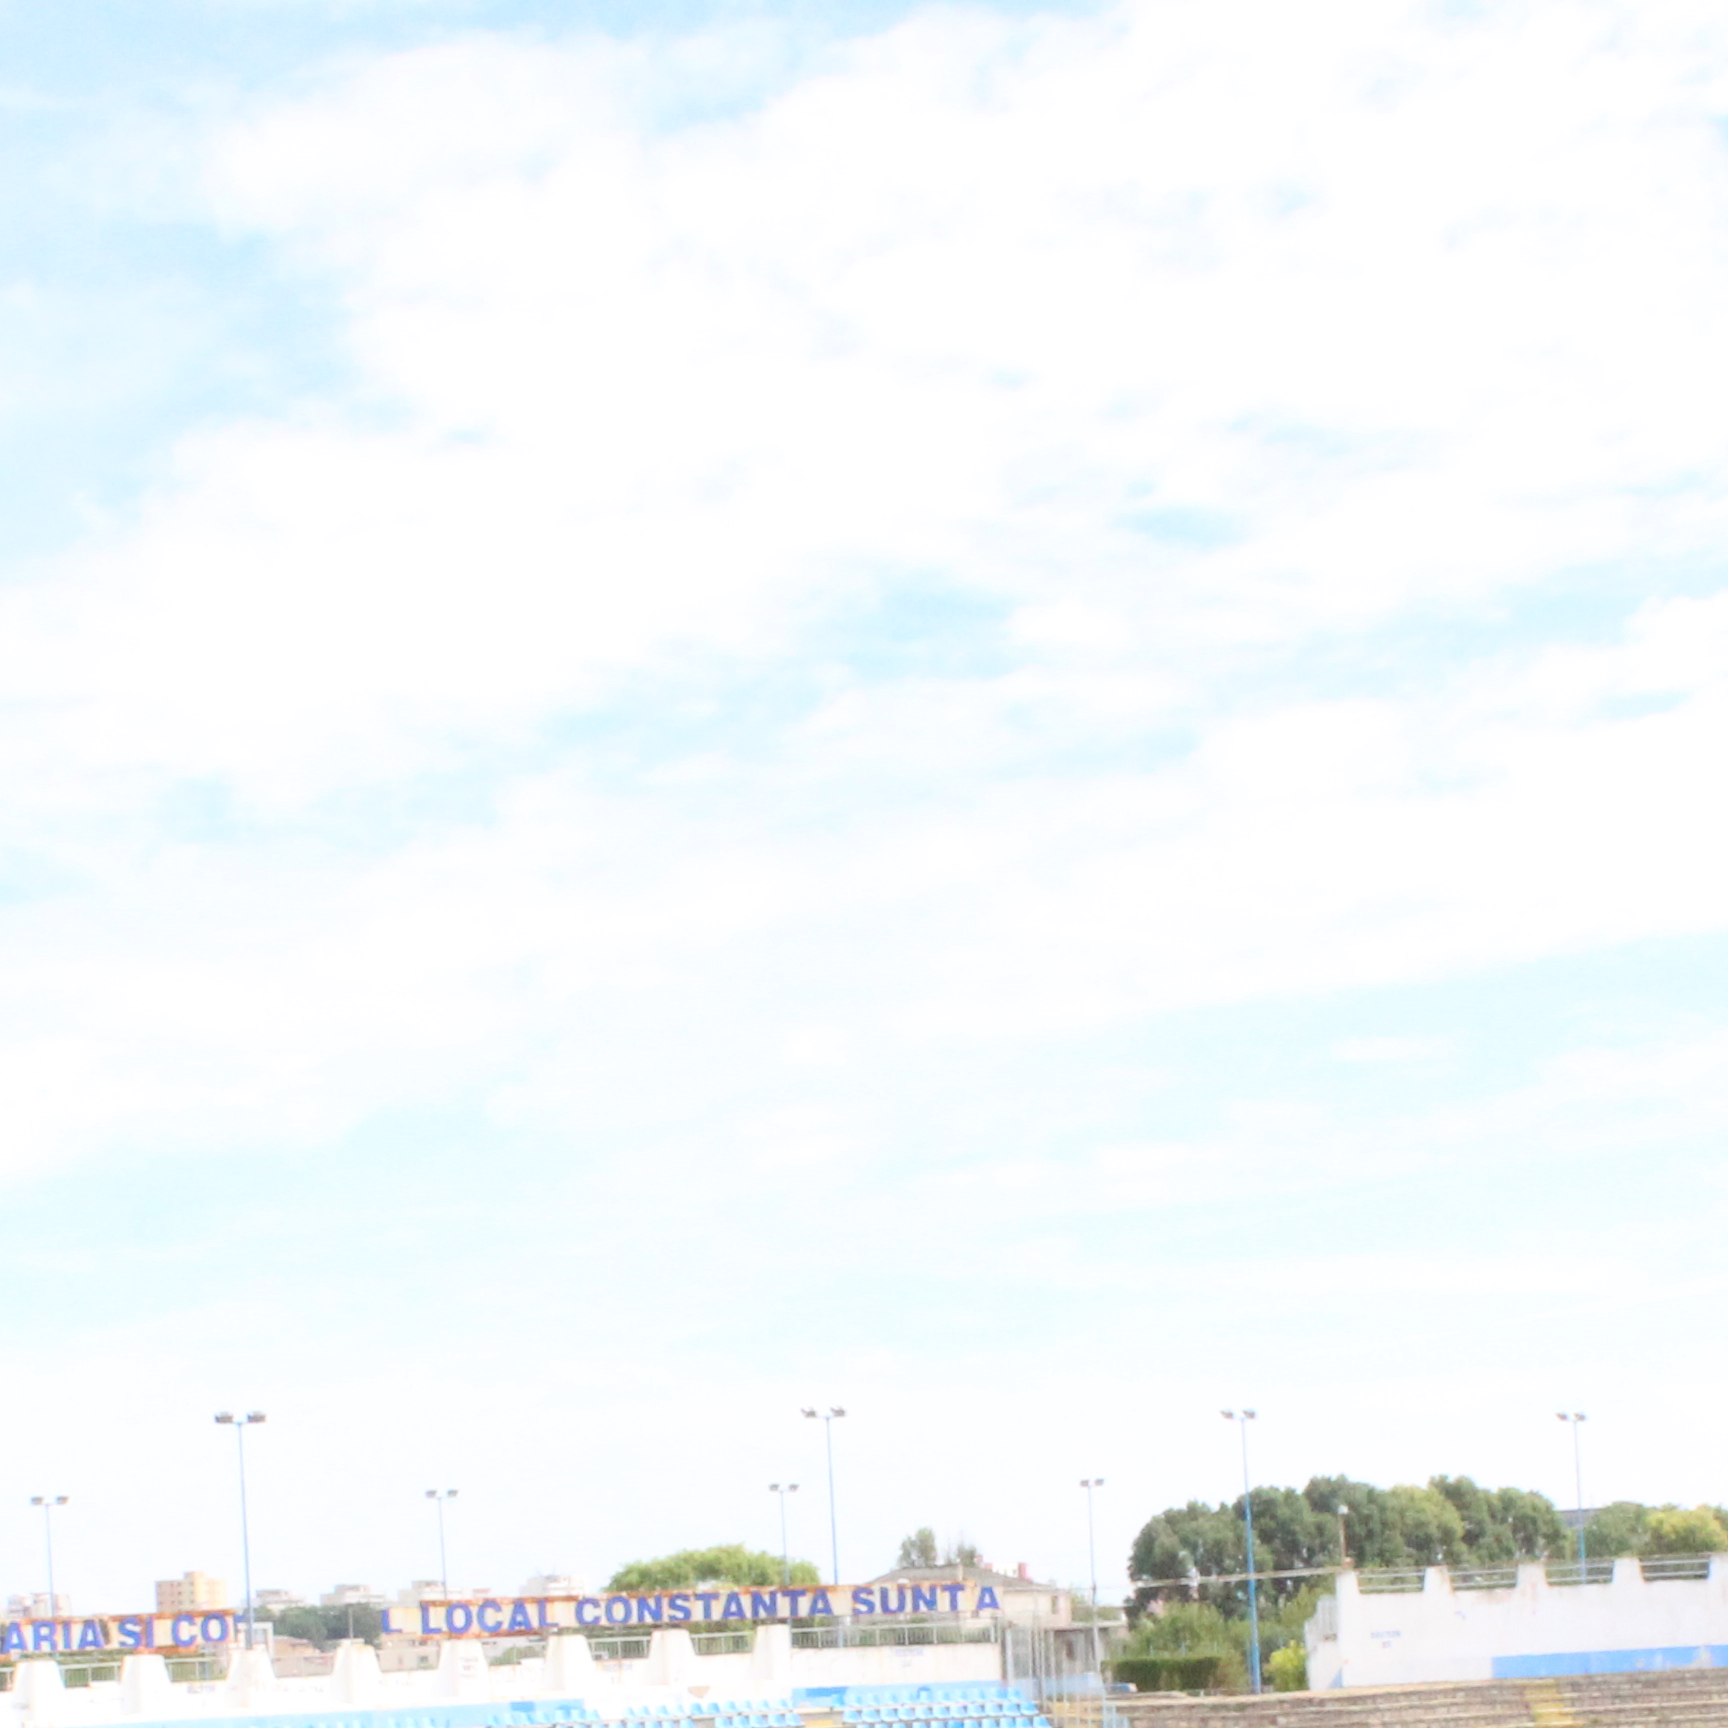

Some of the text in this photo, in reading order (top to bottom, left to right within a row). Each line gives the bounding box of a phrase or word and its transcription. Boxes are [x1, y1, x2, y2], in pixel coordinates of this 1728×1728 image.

[420, 1599, 559, 1635] LOCAL
[575, 1590, 834, 1626] CONSTANTA
[852, 1584, 965, 1615] SUNT
[118, 1617, 155, 1649] SI
